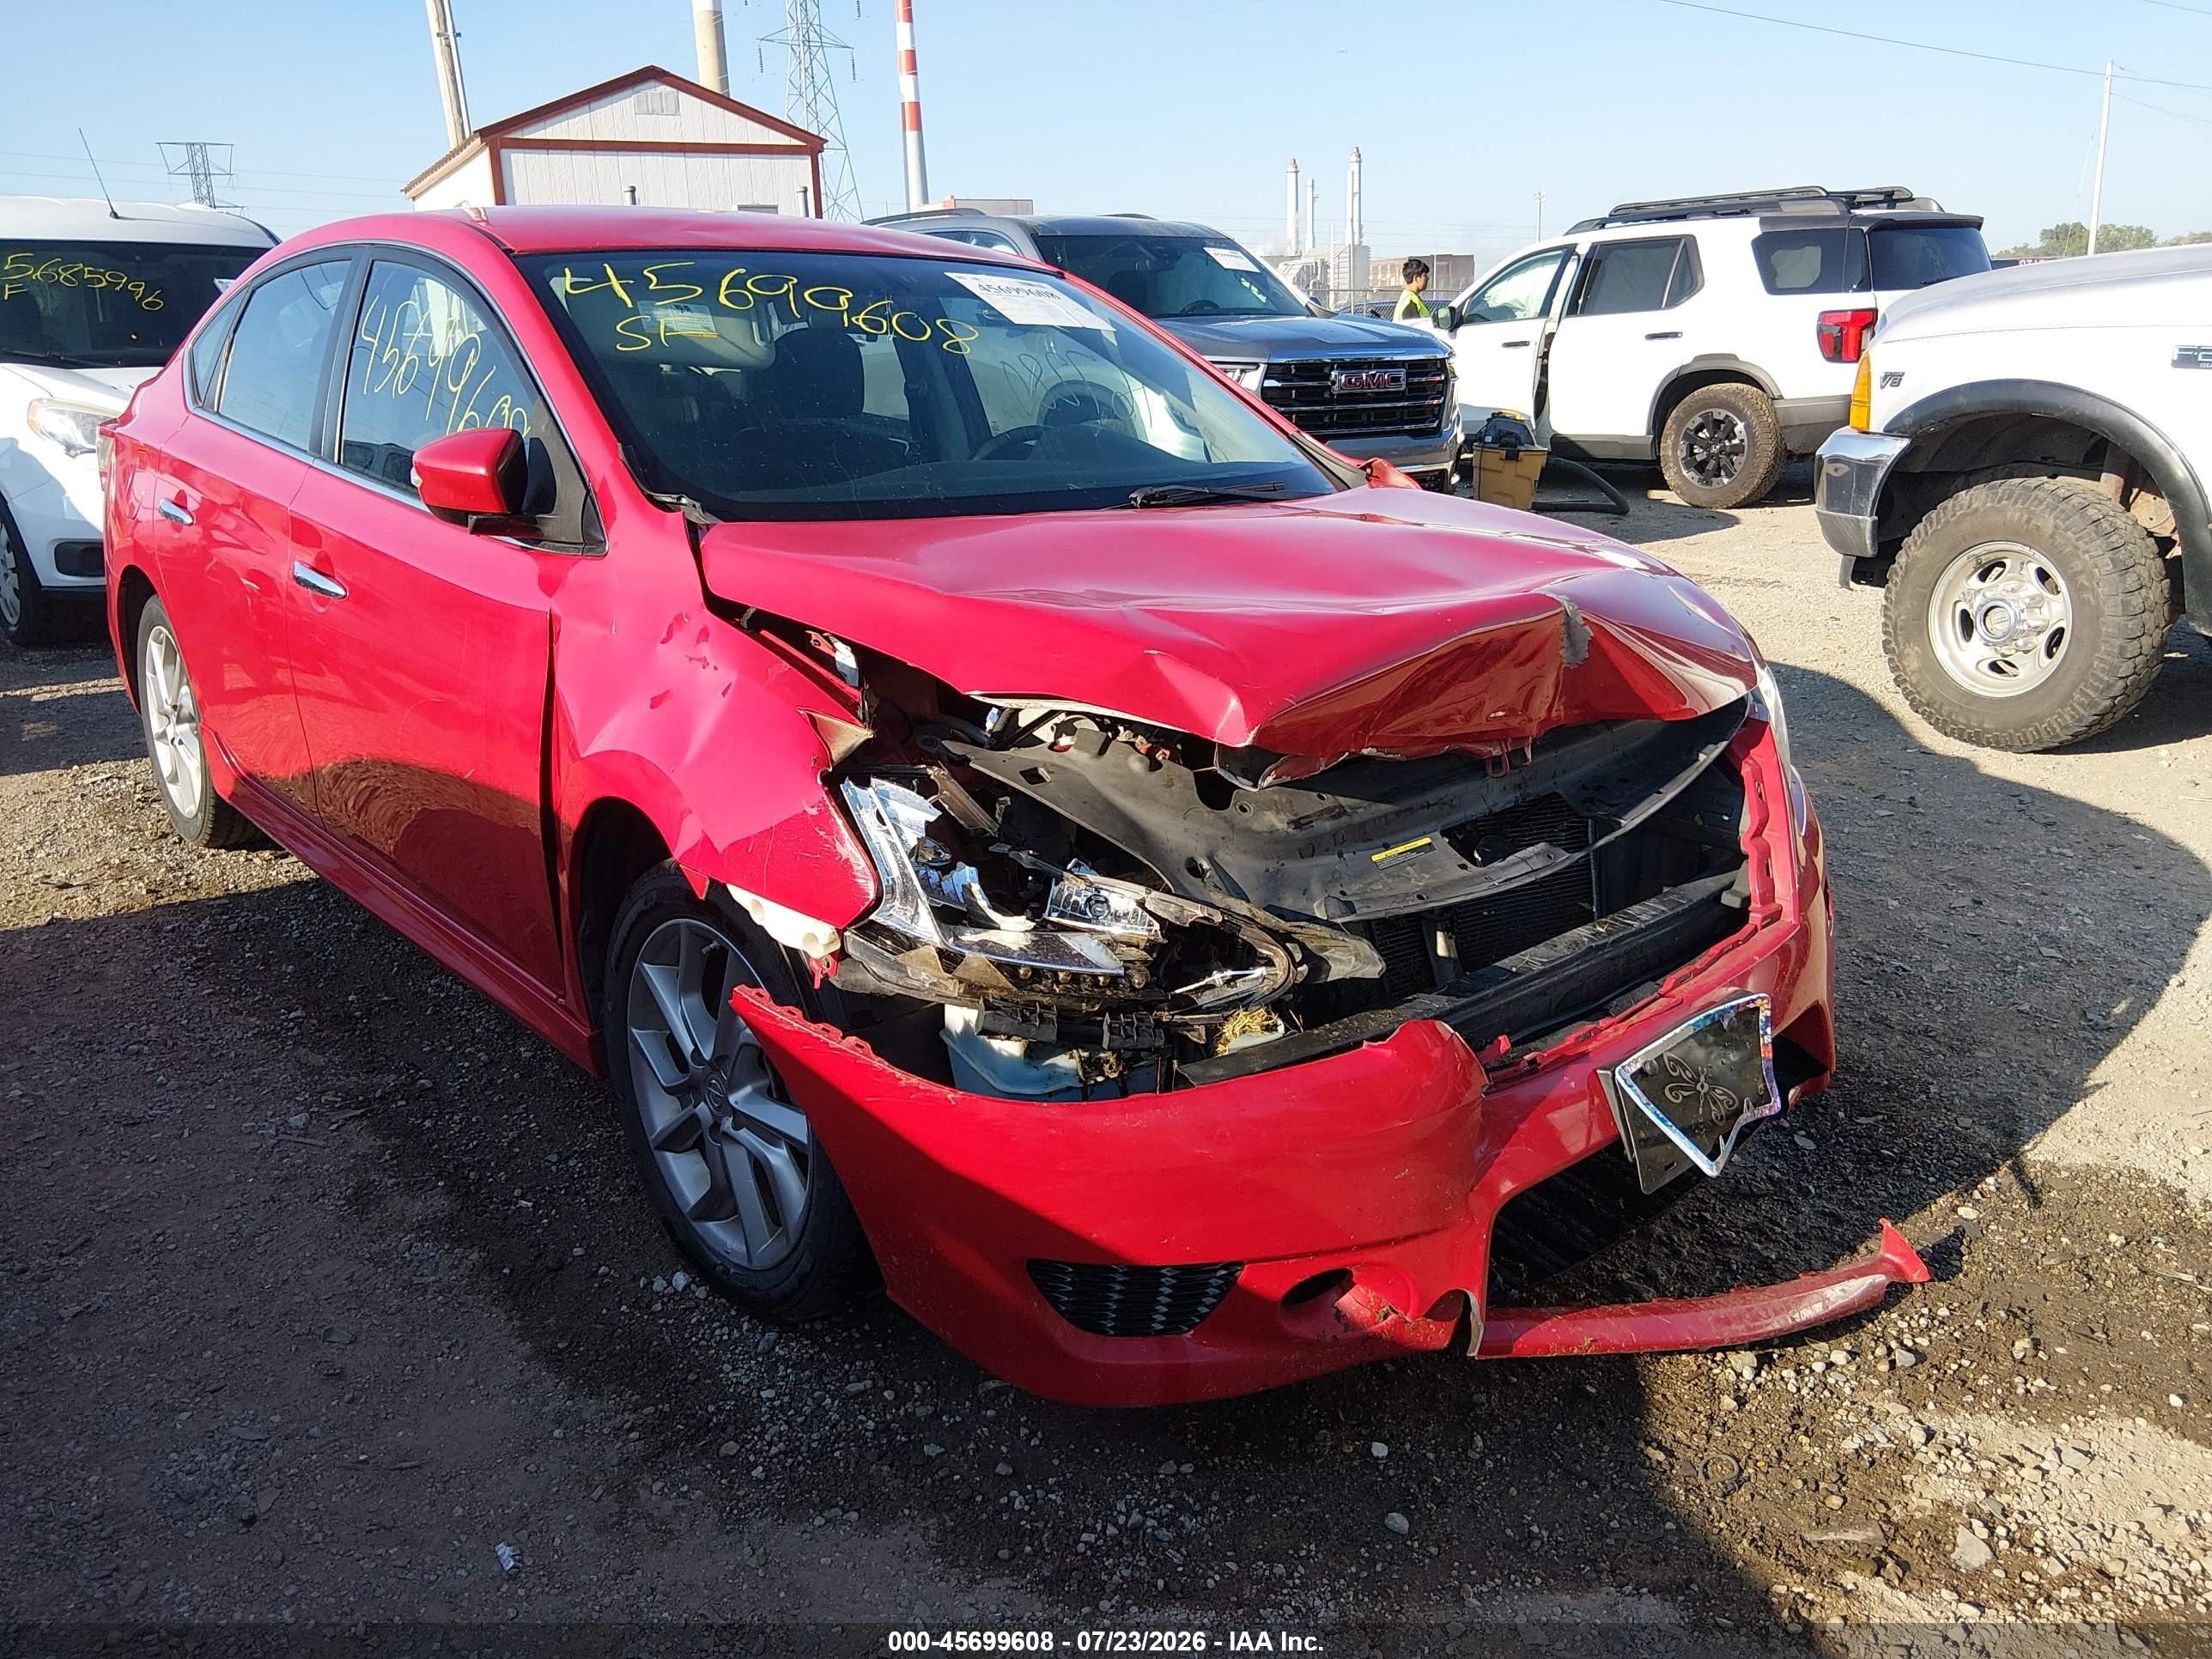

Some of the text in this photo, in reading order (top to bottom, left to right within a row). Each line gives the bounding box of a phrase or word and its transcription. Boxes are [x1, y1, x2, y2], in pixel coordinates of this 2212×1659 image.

[4, 283, 28, 301] F
[564, 261, 980, 355] 45699608
[616, 315, 720, 351] SF
[1340, 372, 1403, 389] GMC
[1880, 374, 1903, 389] V8
